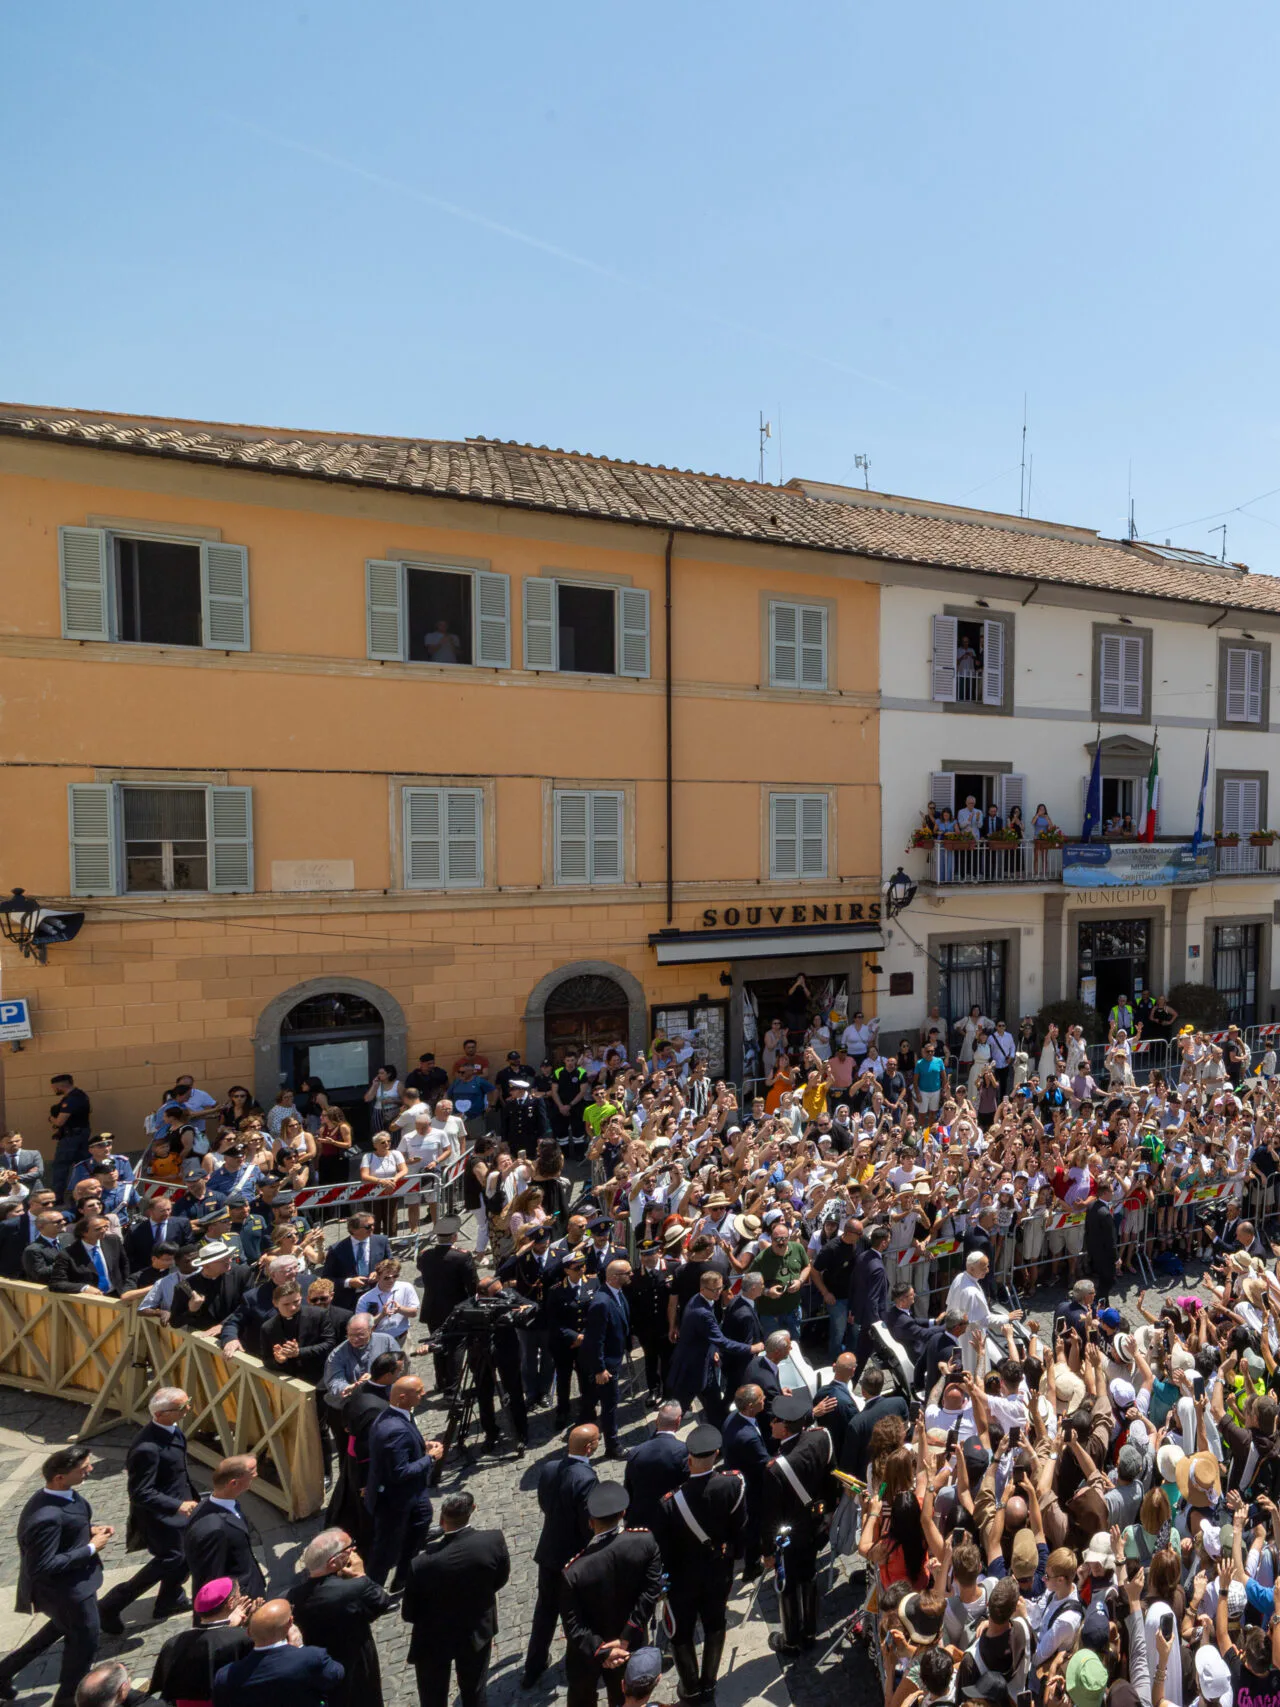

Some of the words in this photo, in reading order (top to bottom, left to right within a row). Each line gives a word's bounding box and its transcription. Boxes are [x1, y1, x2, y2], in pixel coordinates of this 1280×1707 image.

[1076, 889, 1157, 904] MUNICIPIO
[703, 903, 881, 926] SOUVENIRS
[1, 1005, 18, 1022] P
